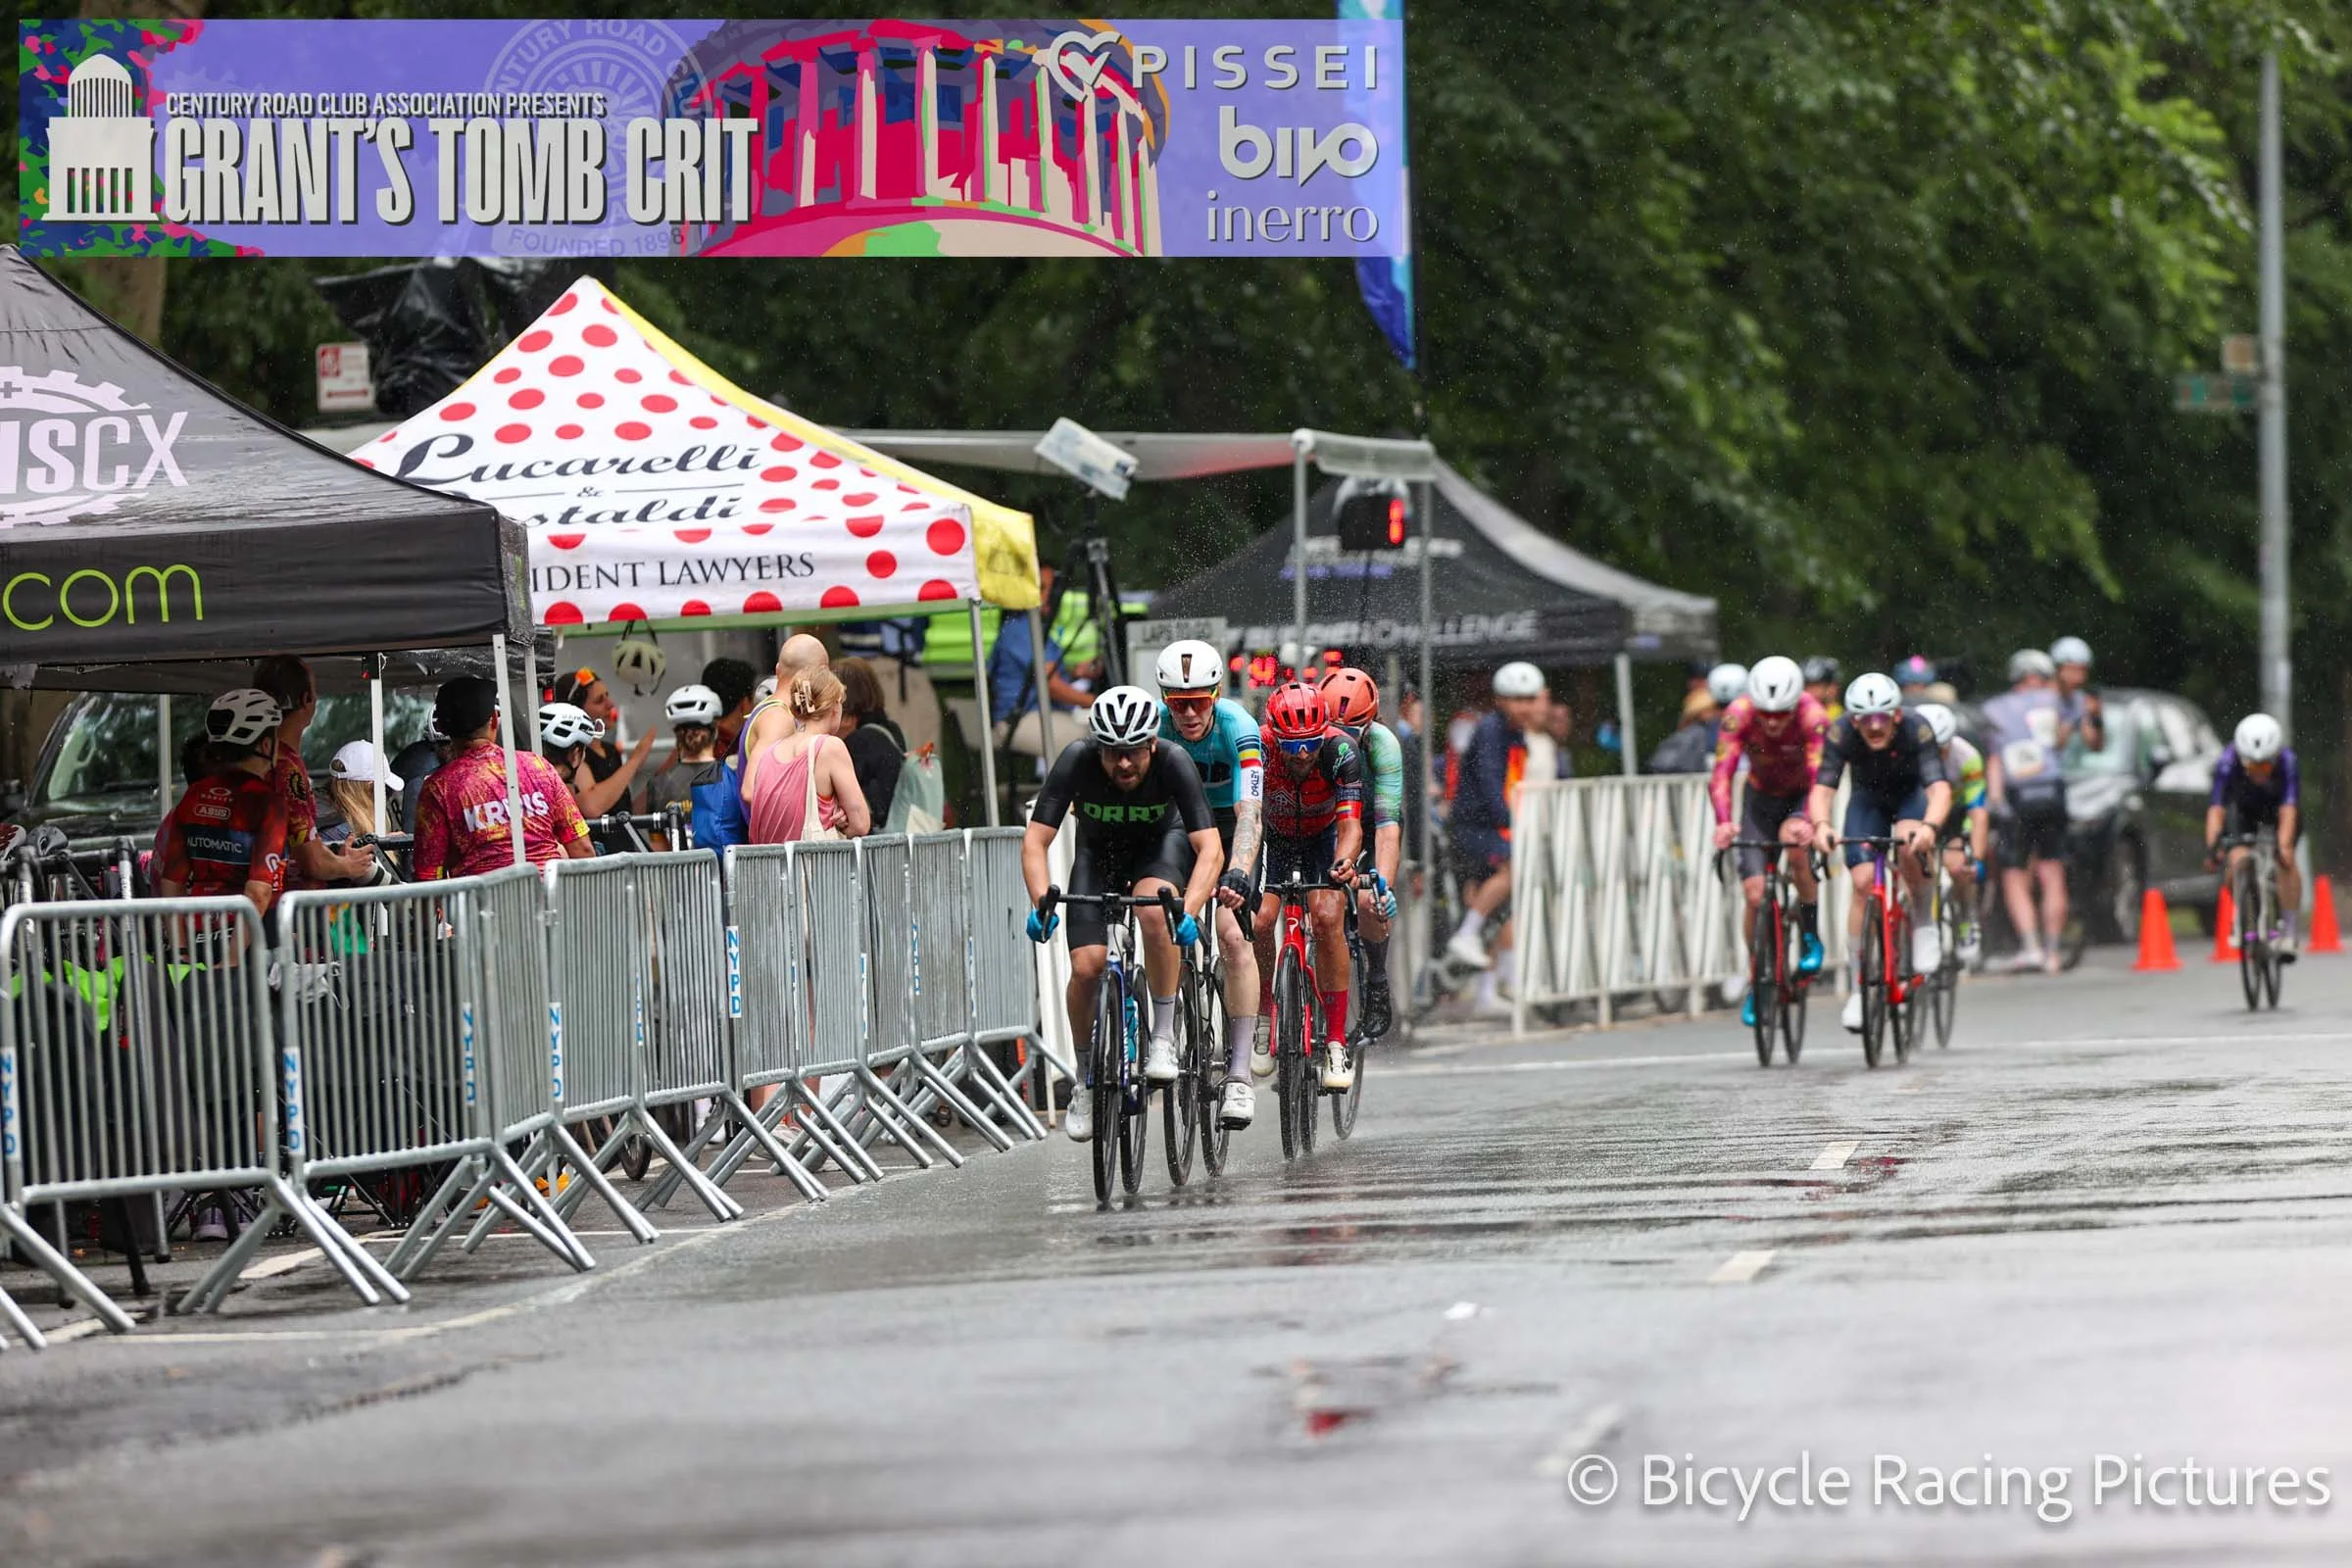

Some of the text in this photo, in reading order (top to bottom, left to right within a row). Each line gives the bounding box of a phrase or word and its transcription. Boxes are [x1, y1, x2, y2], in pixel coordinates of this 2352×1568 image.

[395, 433, 761, 486] Lucarelli
[523, 495, 743, 528] staldi
[531, 561, 646, 593] IDENT
[658, 551, 814, 587] LAWYERS
[2, 564, 203, 631] com
[1250, 768, 1260, 797] OAKLEY
[199, 806, 228, 818] ABUS
[187, 835, 243, 855] AUTOMATIC
[728, 929, 742, 1014] NYPD
[0, 1053, 17, 1156] NYPD
[283, 1053, 301, 1151] NYPD
